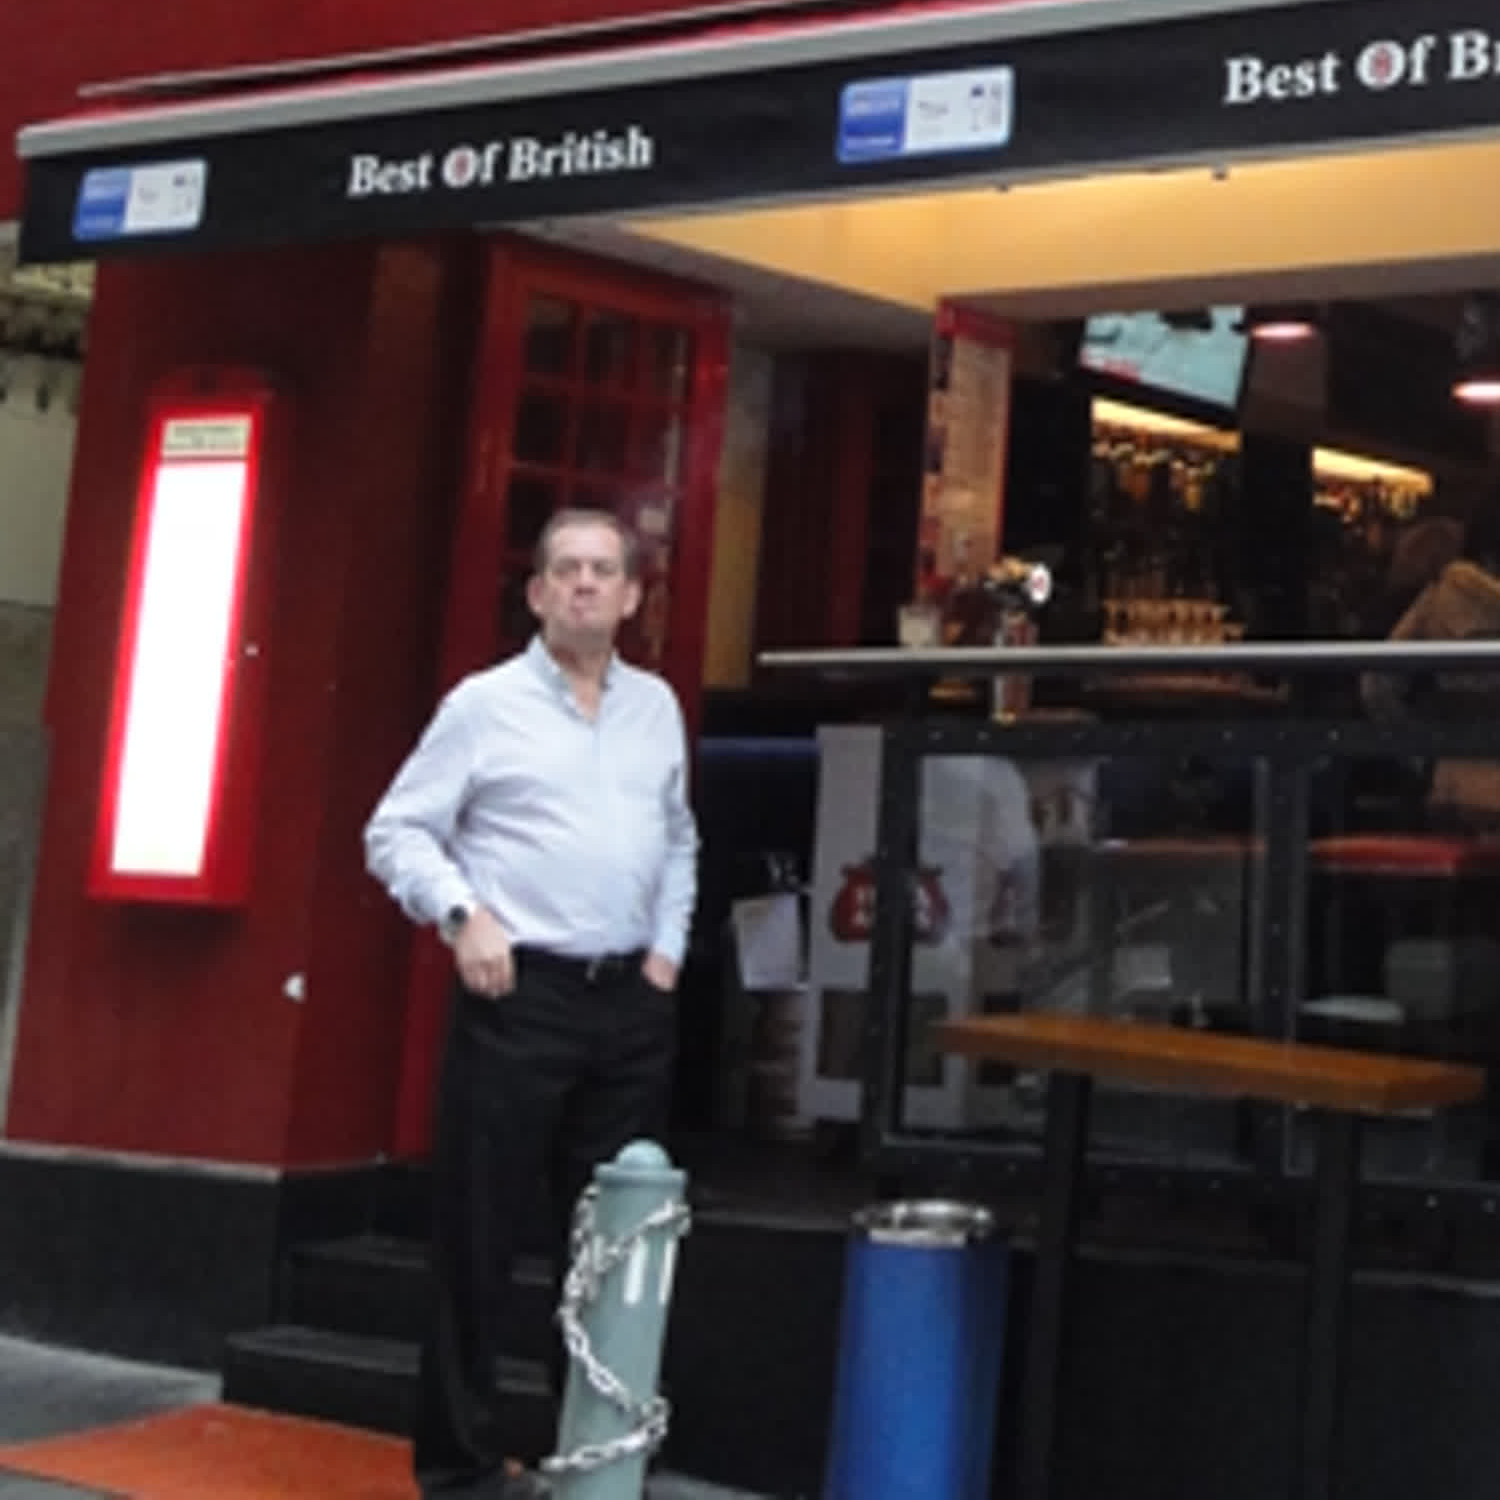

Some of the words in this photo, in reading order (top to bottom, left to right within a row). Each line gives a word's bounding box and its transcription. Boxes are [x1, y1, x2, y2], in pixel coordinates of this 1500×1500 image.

[1225, 52, 1339, 103] Best
[1355, 34, 1437, 89] Of
[347, 153, 432, 196] Best
[506, 125, 654, 182] British
